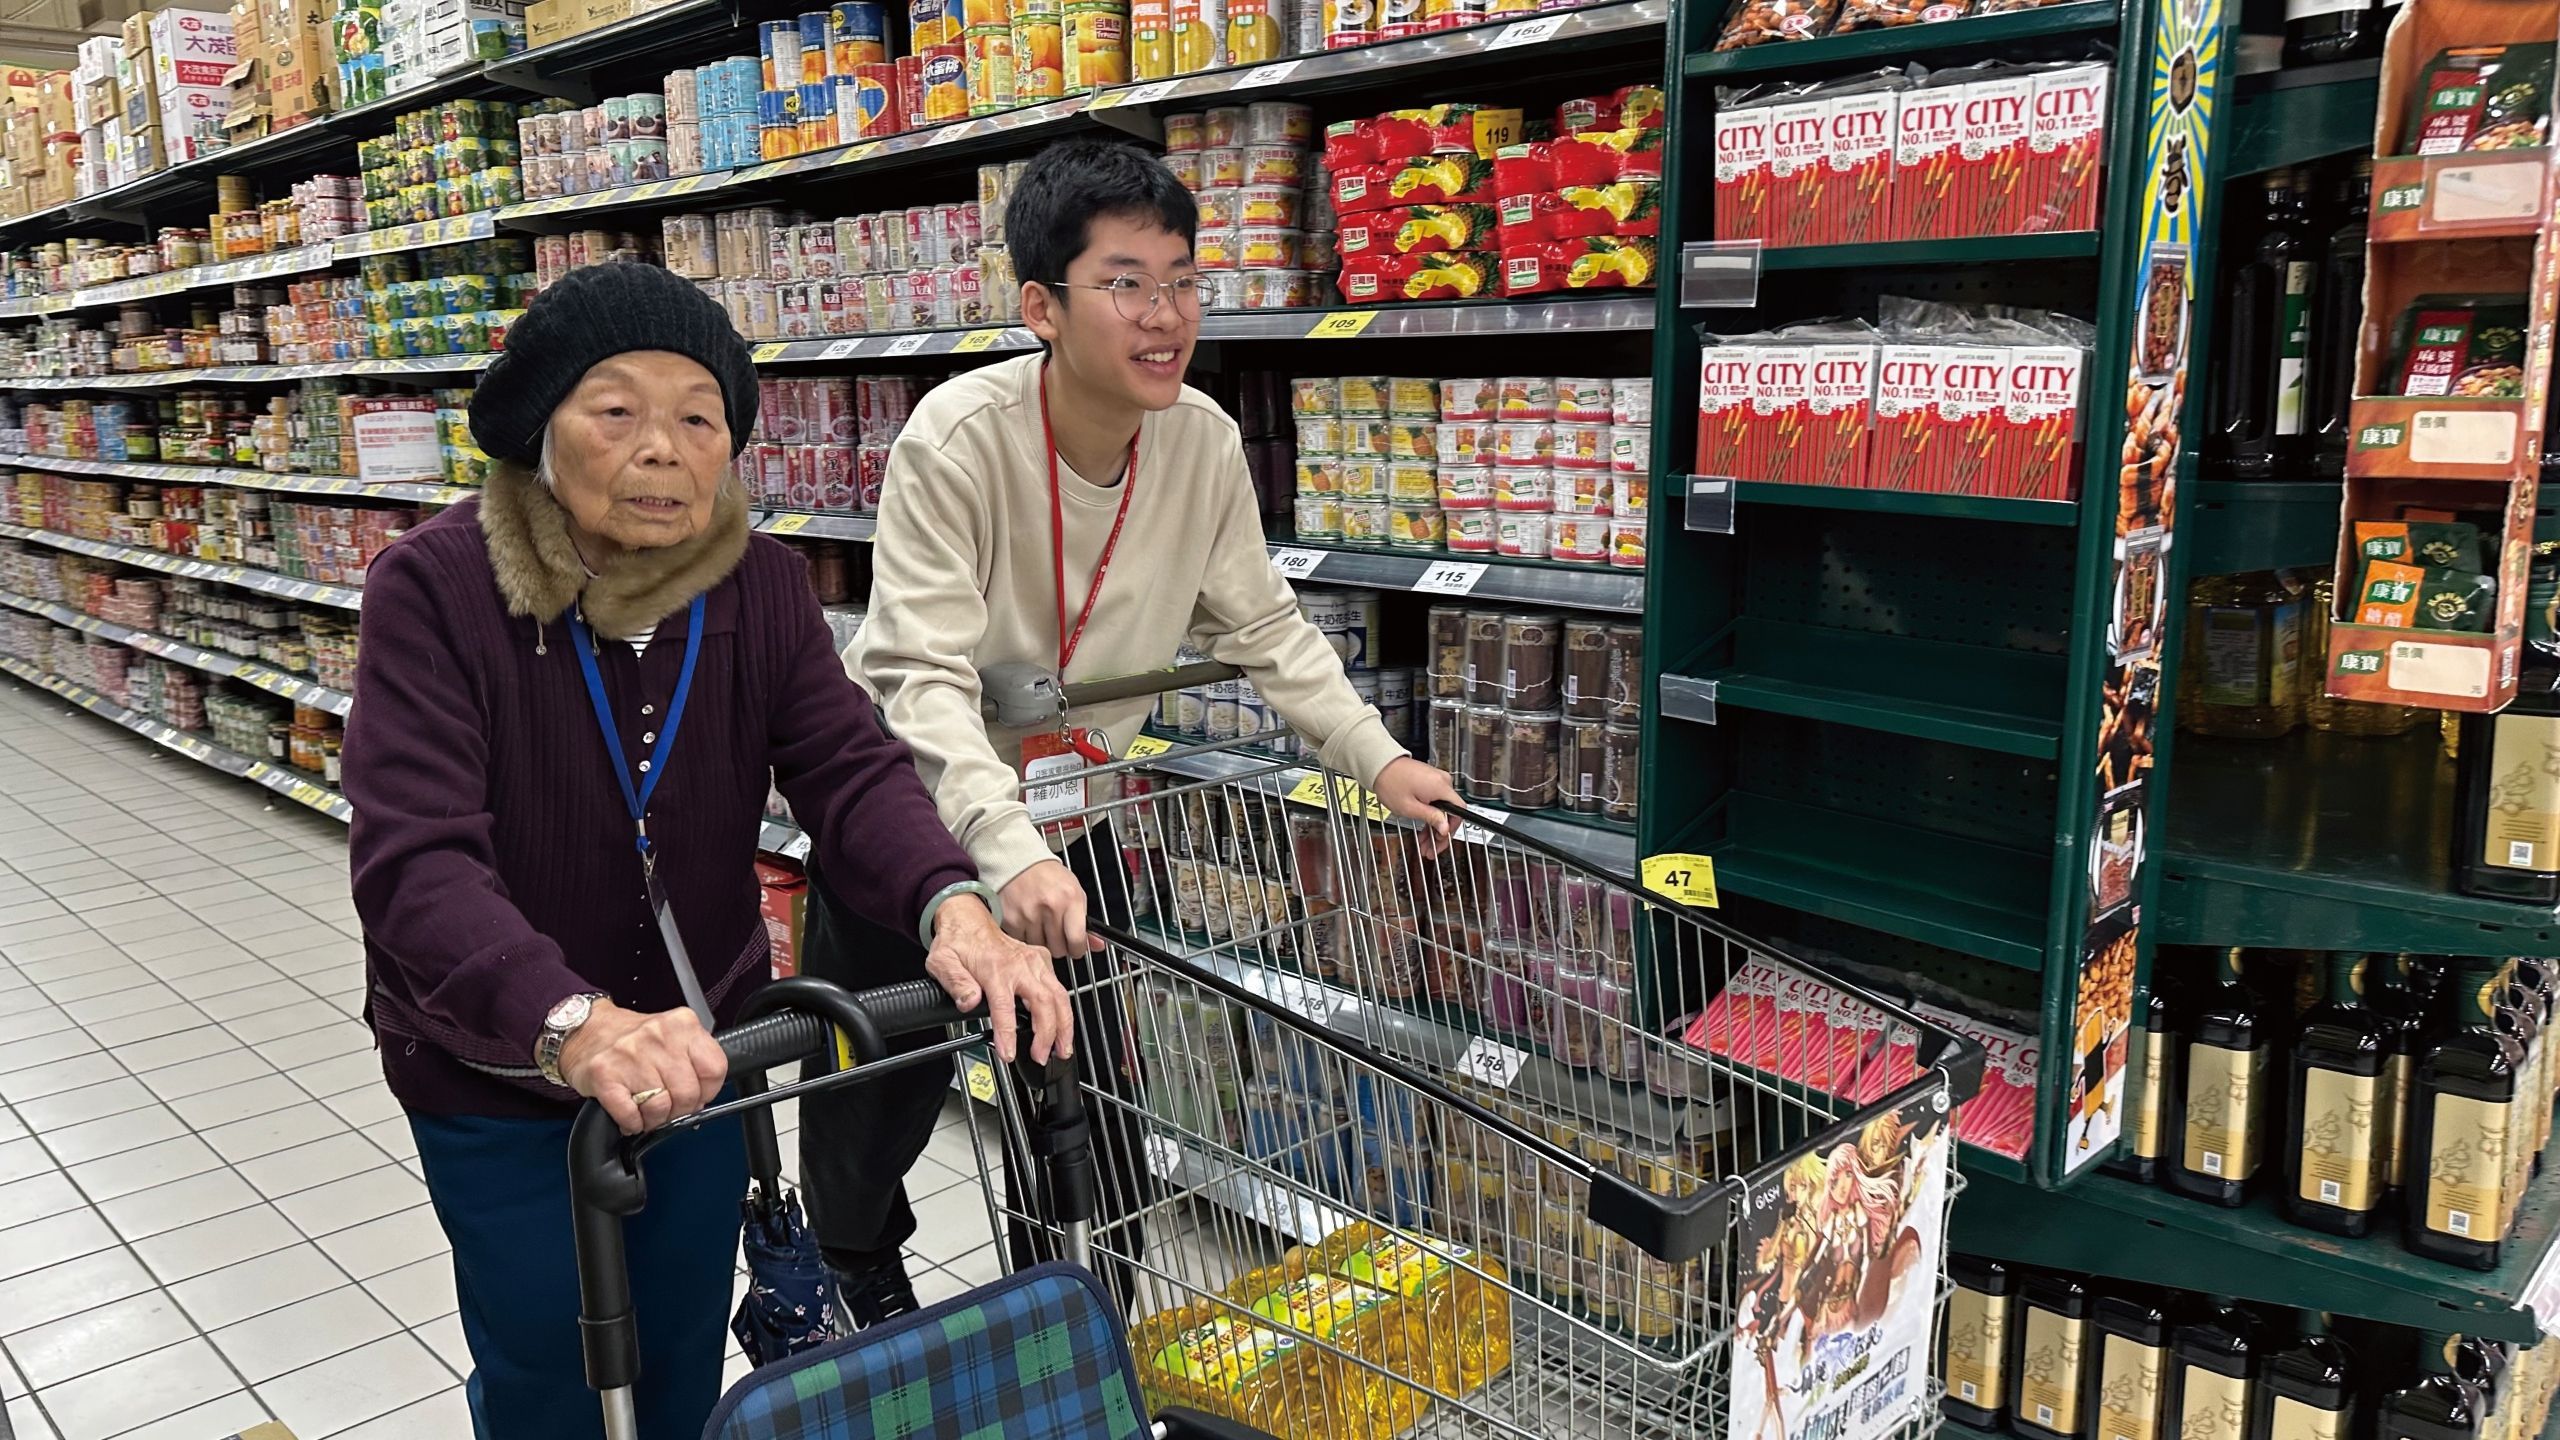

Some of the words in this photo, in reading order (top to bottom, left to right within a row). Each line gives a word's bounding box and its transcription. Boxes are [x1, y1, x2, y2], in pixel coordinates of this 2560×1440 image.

[1512, 24, 1545, 37] 160
[2036, 86, 2100, 117] CITY
[2436, 91, 2477, 106] 康寶
[1903, 103, 1959, 132] CITY
[1965, 96, 2026, 126] CITY
[1774, 117, 1826, 145] CITY
[1833, 110, 1887, 138] CITY
[2035, 117, 2067, 132] NO.1
[1486, 127, 1509, 144] 119
[1718, 124, 1766, 151] CITY
[1902, 132, 1930, 146] NO.1
[1965, 126, 1995, 139] NO.1
[1775, 145, 1800, 158] NO.1
[1833, 139, 1860, 151] NO.1
[1718, 151, 1743, 164] NO.1
[1328, 319, 1356, 330] 109
[2423, 328, 2462, 342] 康寶
[1704, 363, 1752, 383] CITY
[1757, 363, 1807, 385] CITY
[1814, 361, 1868, 383] CITY
[1882, 362, 1939, 386] CITY
[1944, 364, 2004, 389] CITY
[2011, 365, 2075, 391] CITY
[1704, 385, 1727, 396] NO.1
[1757, 386, 1781, 397] NO.1
[1814, 385, 1841, 396] NO.1
[1881, 387, 1910, 399] NO.1
[1943, 390, 1972, 402] NO.1
[2010, 391, 2042, 404] NO.1
[2361, 428, 2402, 445] 康寶
[2366, 541, 2400, 556] 康寶
[1281, 556, 1307, 568] 180
[1435, 571, 1466, 582] 115
[2371, 583, 2411, 603] 康寶
[2340, 653, 2379, 671] 康寶
[1131, 745, 1155, 756] 154
[1308, 783, 1326, 795] 15
[1665, 870, 1691, 886] 47
[1740, 965, 1789, 984] CITY
[1789, 979, 1838, 1003] CITY
[1475, 1052, 1504, 1071] 158
[970, 1073, 991, 1088] 294
